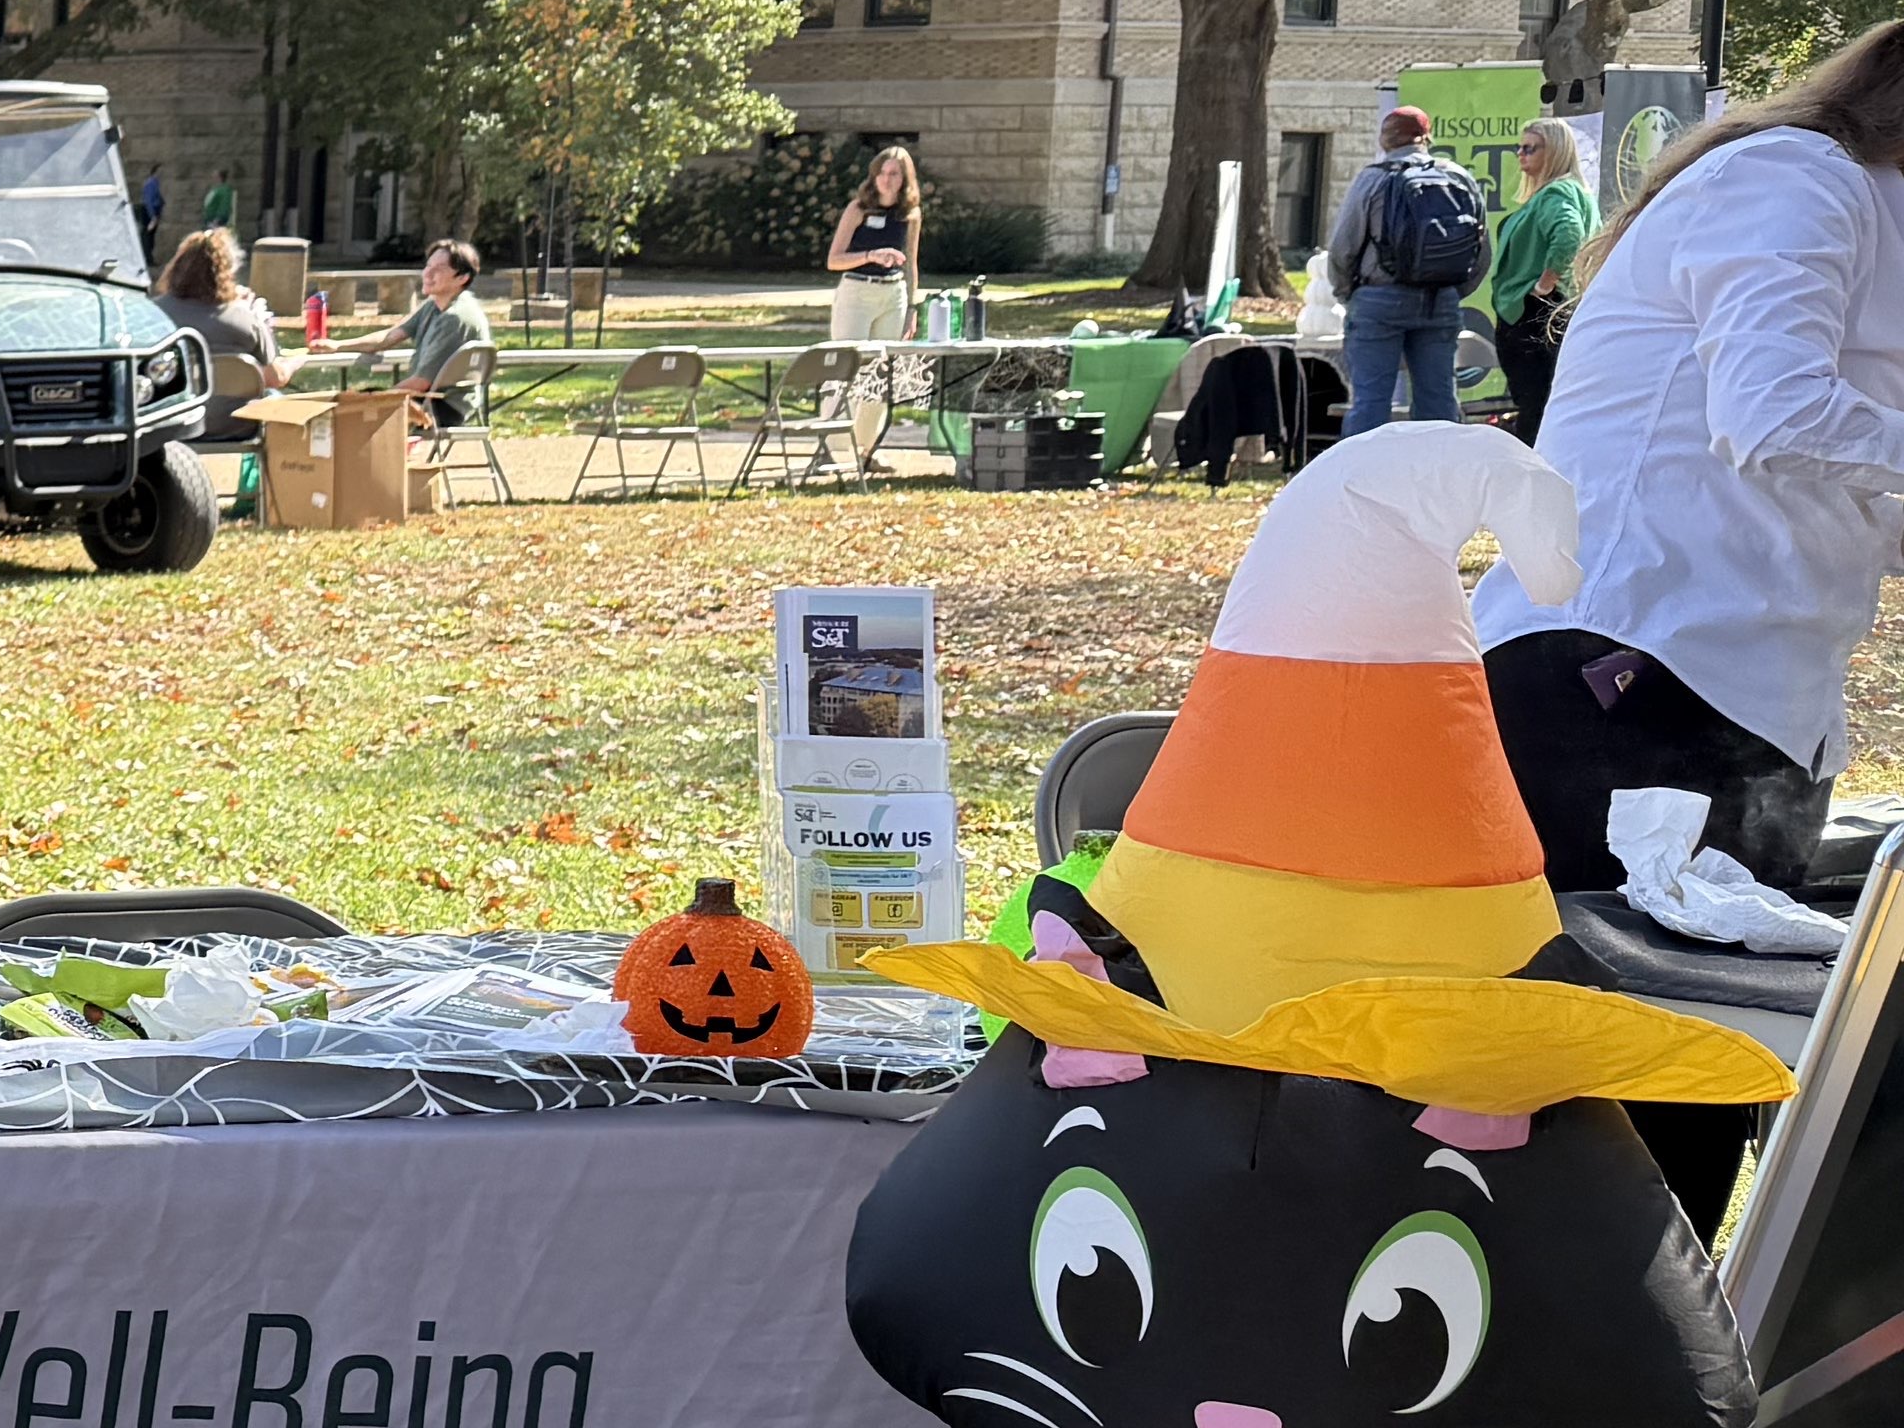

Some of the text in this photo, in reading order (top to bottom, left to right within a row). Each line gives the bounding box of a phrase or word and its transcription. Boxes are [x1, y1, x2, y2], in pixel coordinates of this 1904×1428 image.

[1433, 116, 1519, 138] ISSOURI
[811, 627, 849, 648] S&T
[800, 828, 933, 848] FOLLOW US
